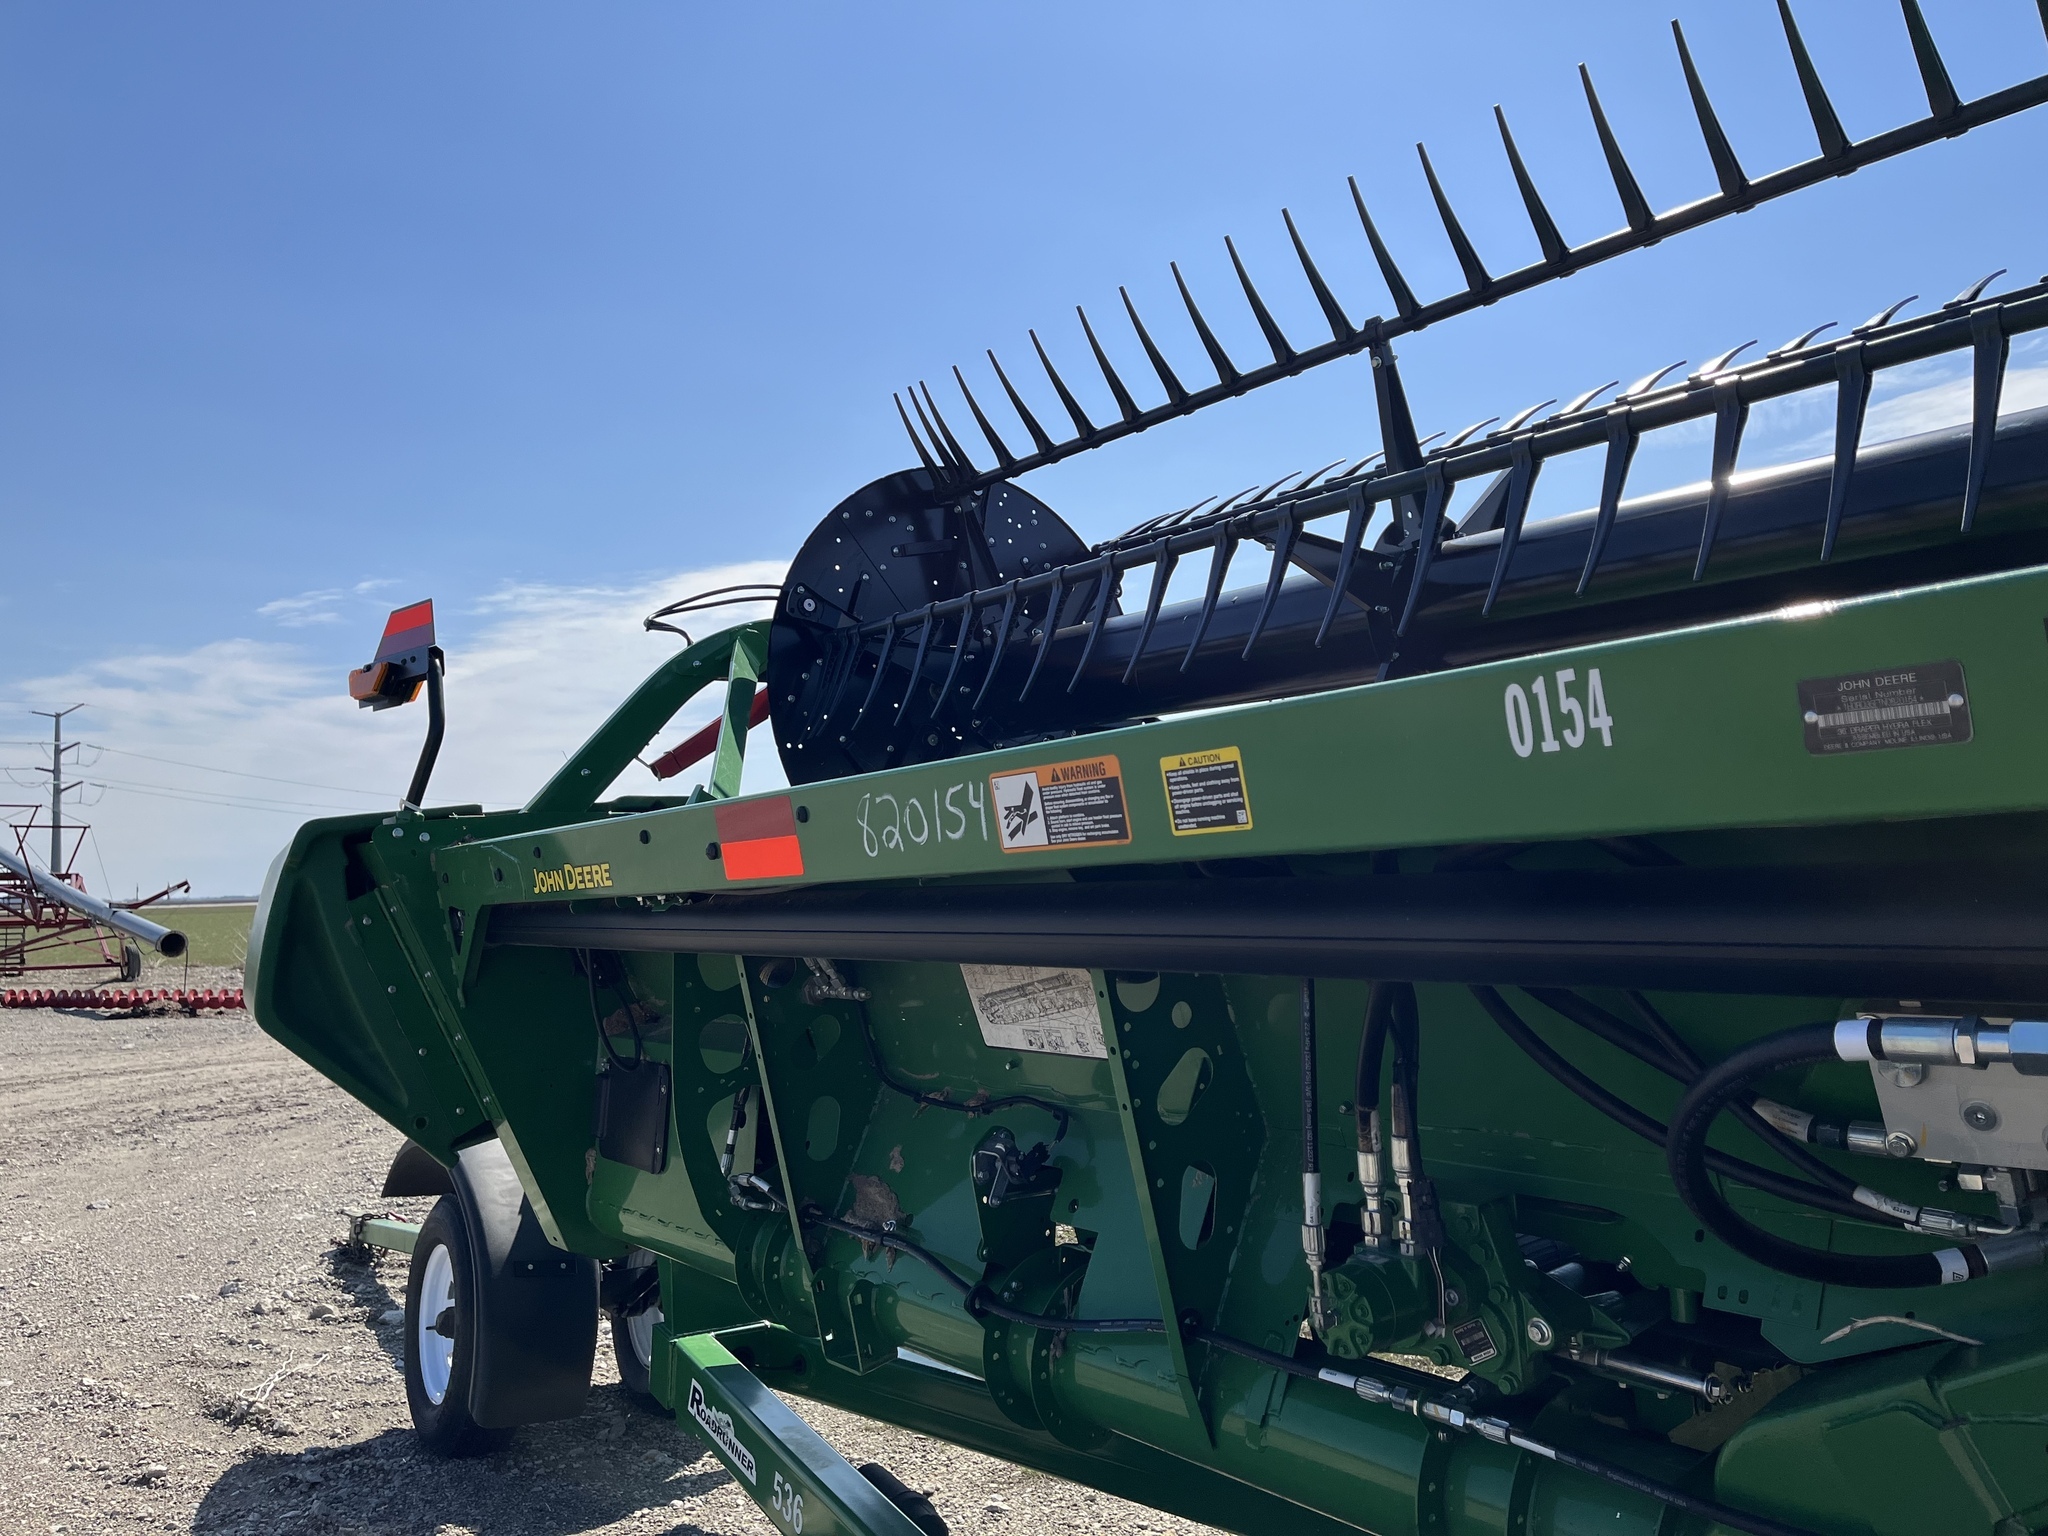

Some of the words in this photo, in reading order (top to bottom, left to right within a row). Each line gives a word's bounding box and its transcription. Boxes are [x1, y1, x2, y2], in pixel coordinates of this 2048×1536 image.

[1838, 679, 1870, 692] JOHN
[1875, 673, 1917, 686] DEERE
[1841, 692, 1871, 703] Serial
[1875, 688, 1916, 698] Number
[1505, 668, 1613, 758] 0154
[1061, 762, 1106, 781] WARNING
[1188, 753, 1220, 765] CAUTION
[857, 781, 987, 857] 820154
[534, 867, 564, 894] JOHN
[564, 862, 613, 890] DEERE
[1308, 1163, 1313, 1171] R1
[690, 1385, 754, 1476] ROADRUNNER
[772, 1471, 803, 1534] 536
